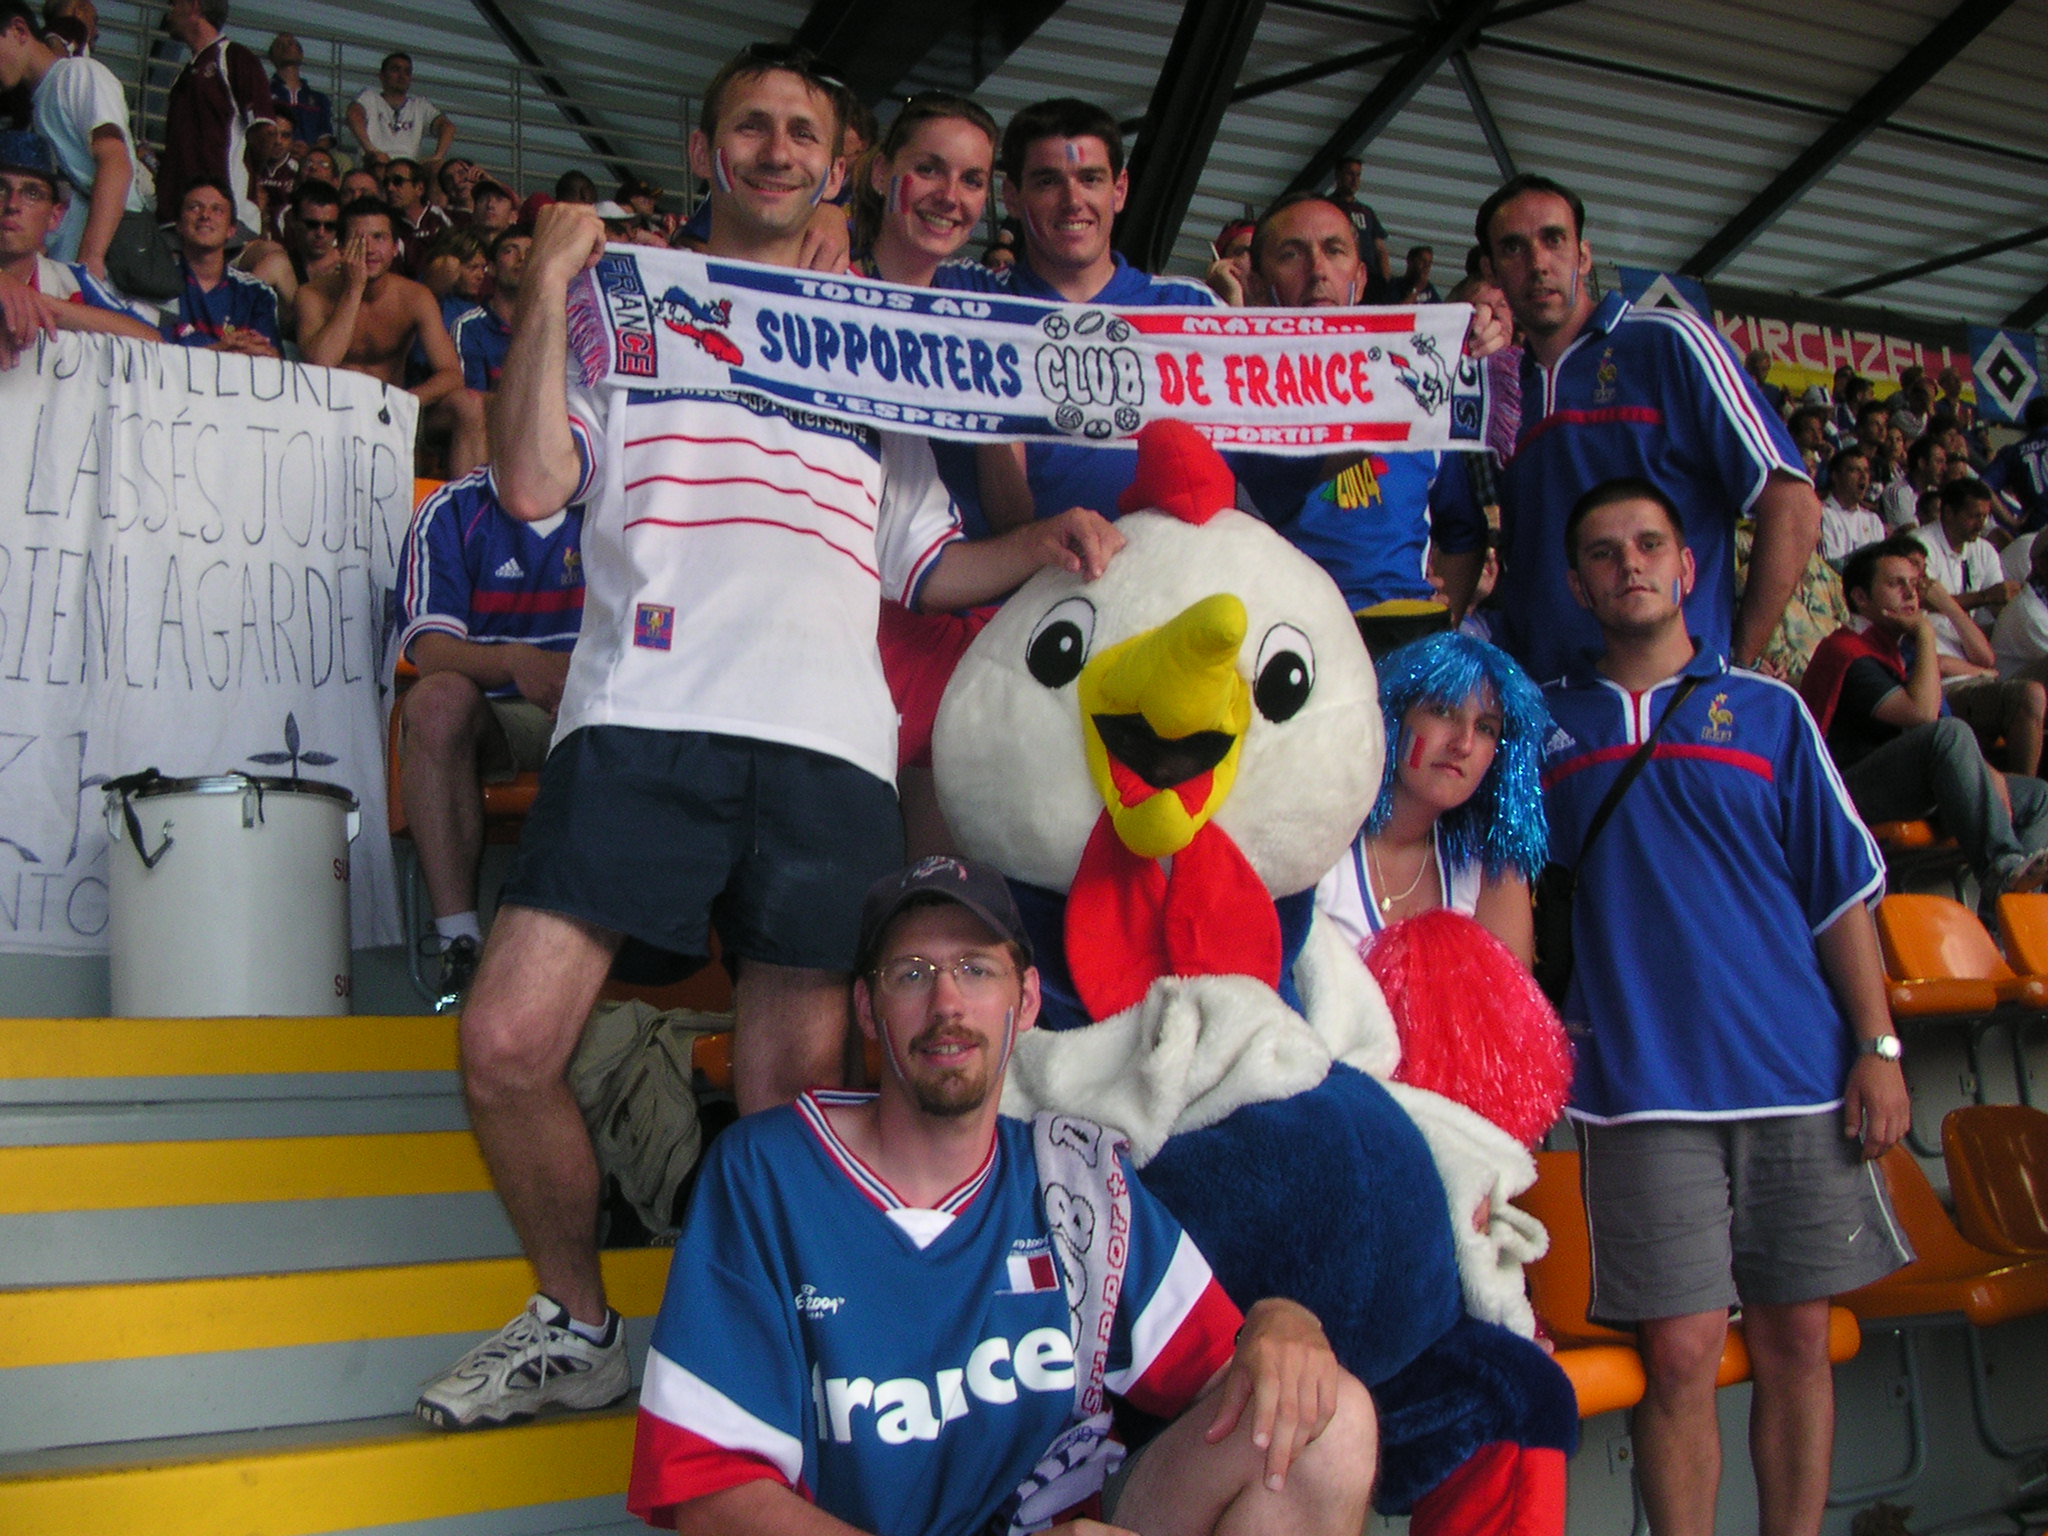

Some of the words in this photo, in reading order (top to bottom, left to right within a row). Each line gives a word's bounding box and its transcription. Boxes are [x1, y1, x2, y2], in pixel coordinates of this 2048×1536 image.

[605, 254, 653, 373] FRANCE
[796, 279, 915, 312] TOUS
[932, 298, 992, 318] AU
[755, 307, 1023, 397] SUPPORTERS
[1034, 343, 1145, 406] CLUB
[1154, 351, 1213, 406] DE
[812, 390, 1005, 431] L'ESPRIT
